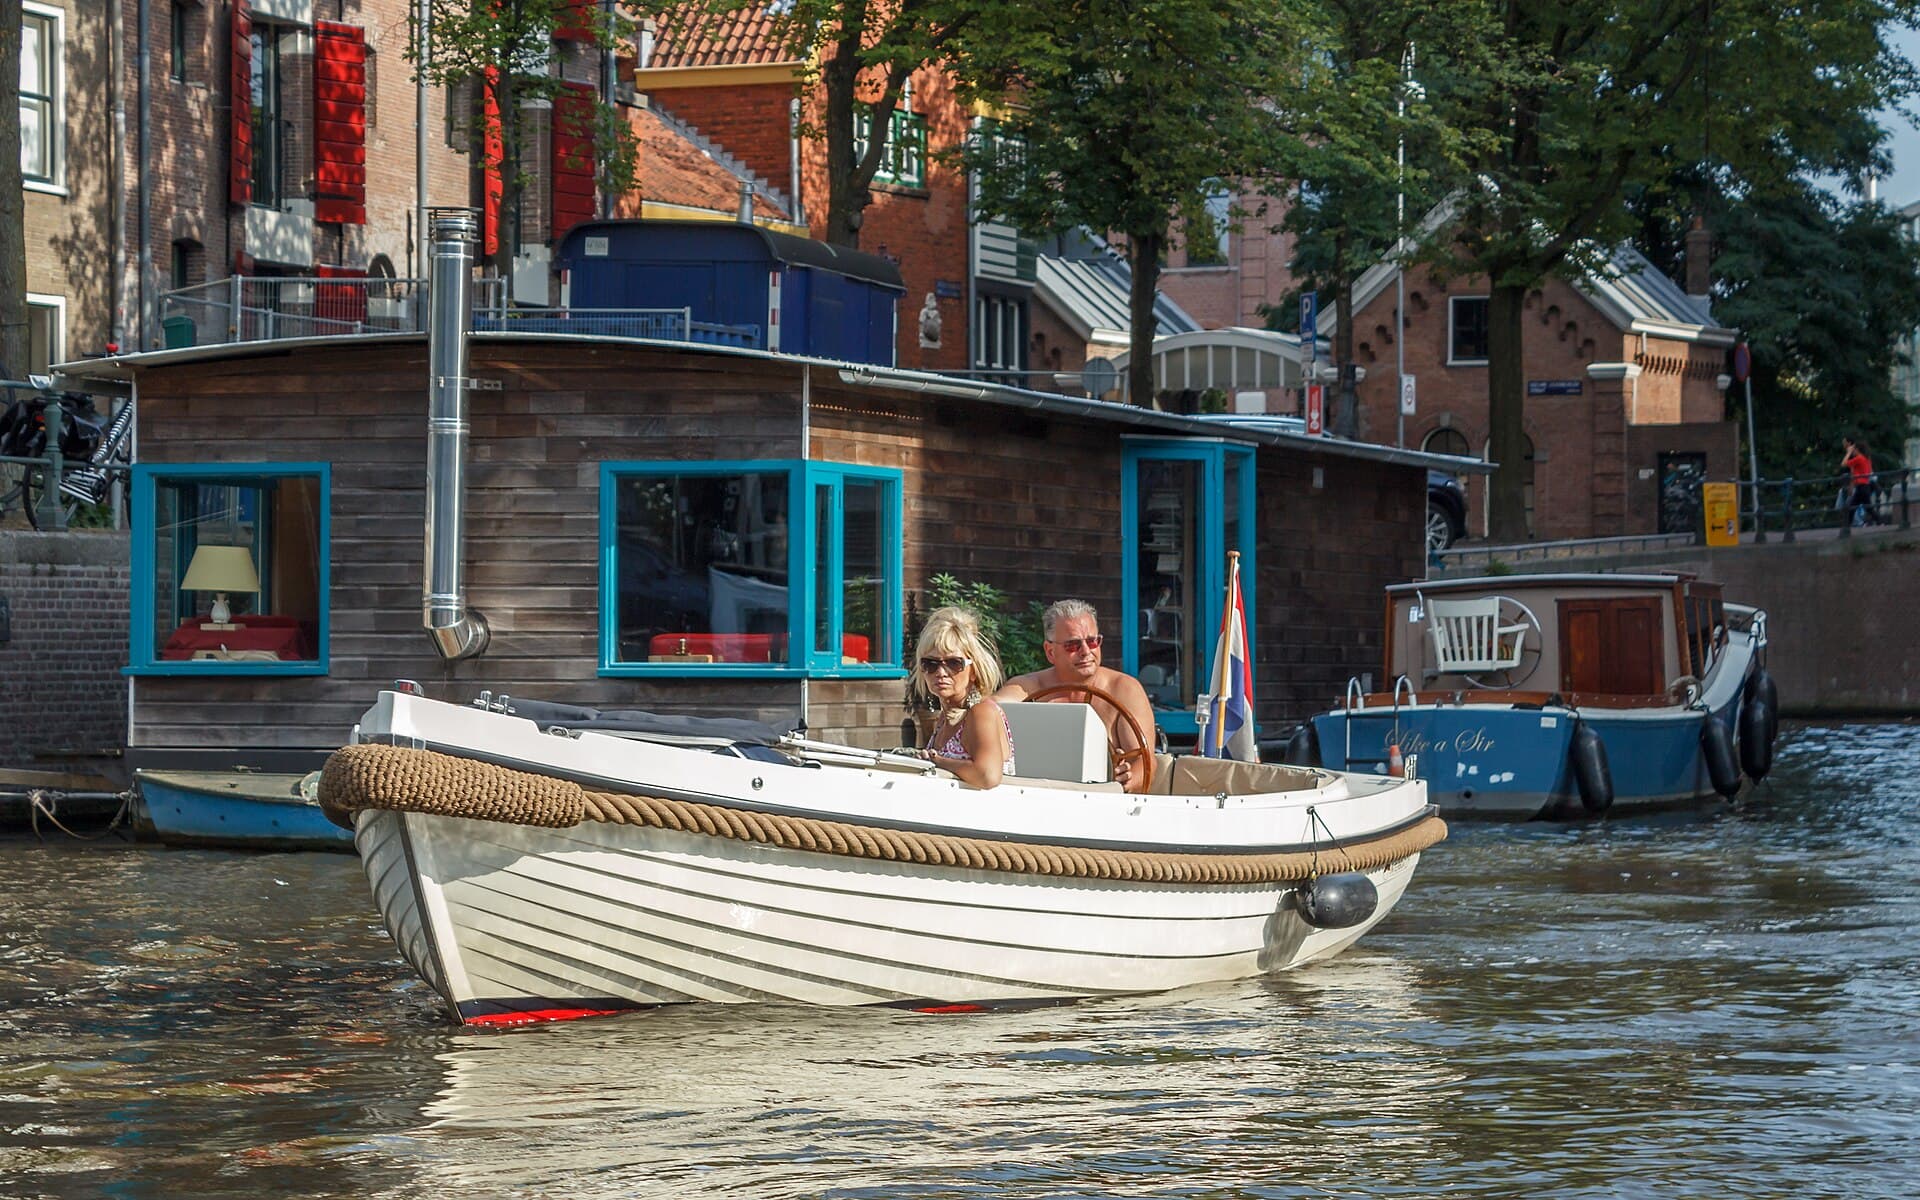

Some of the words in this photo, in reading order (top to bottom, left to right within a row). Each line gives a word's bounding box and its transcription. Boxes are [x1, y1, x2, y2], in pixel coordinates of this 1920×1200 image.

[1302, 297, 1311, 323] P
[1434, 740, 1448, 752] a
[1454, 727, 1496, 757] Sir
